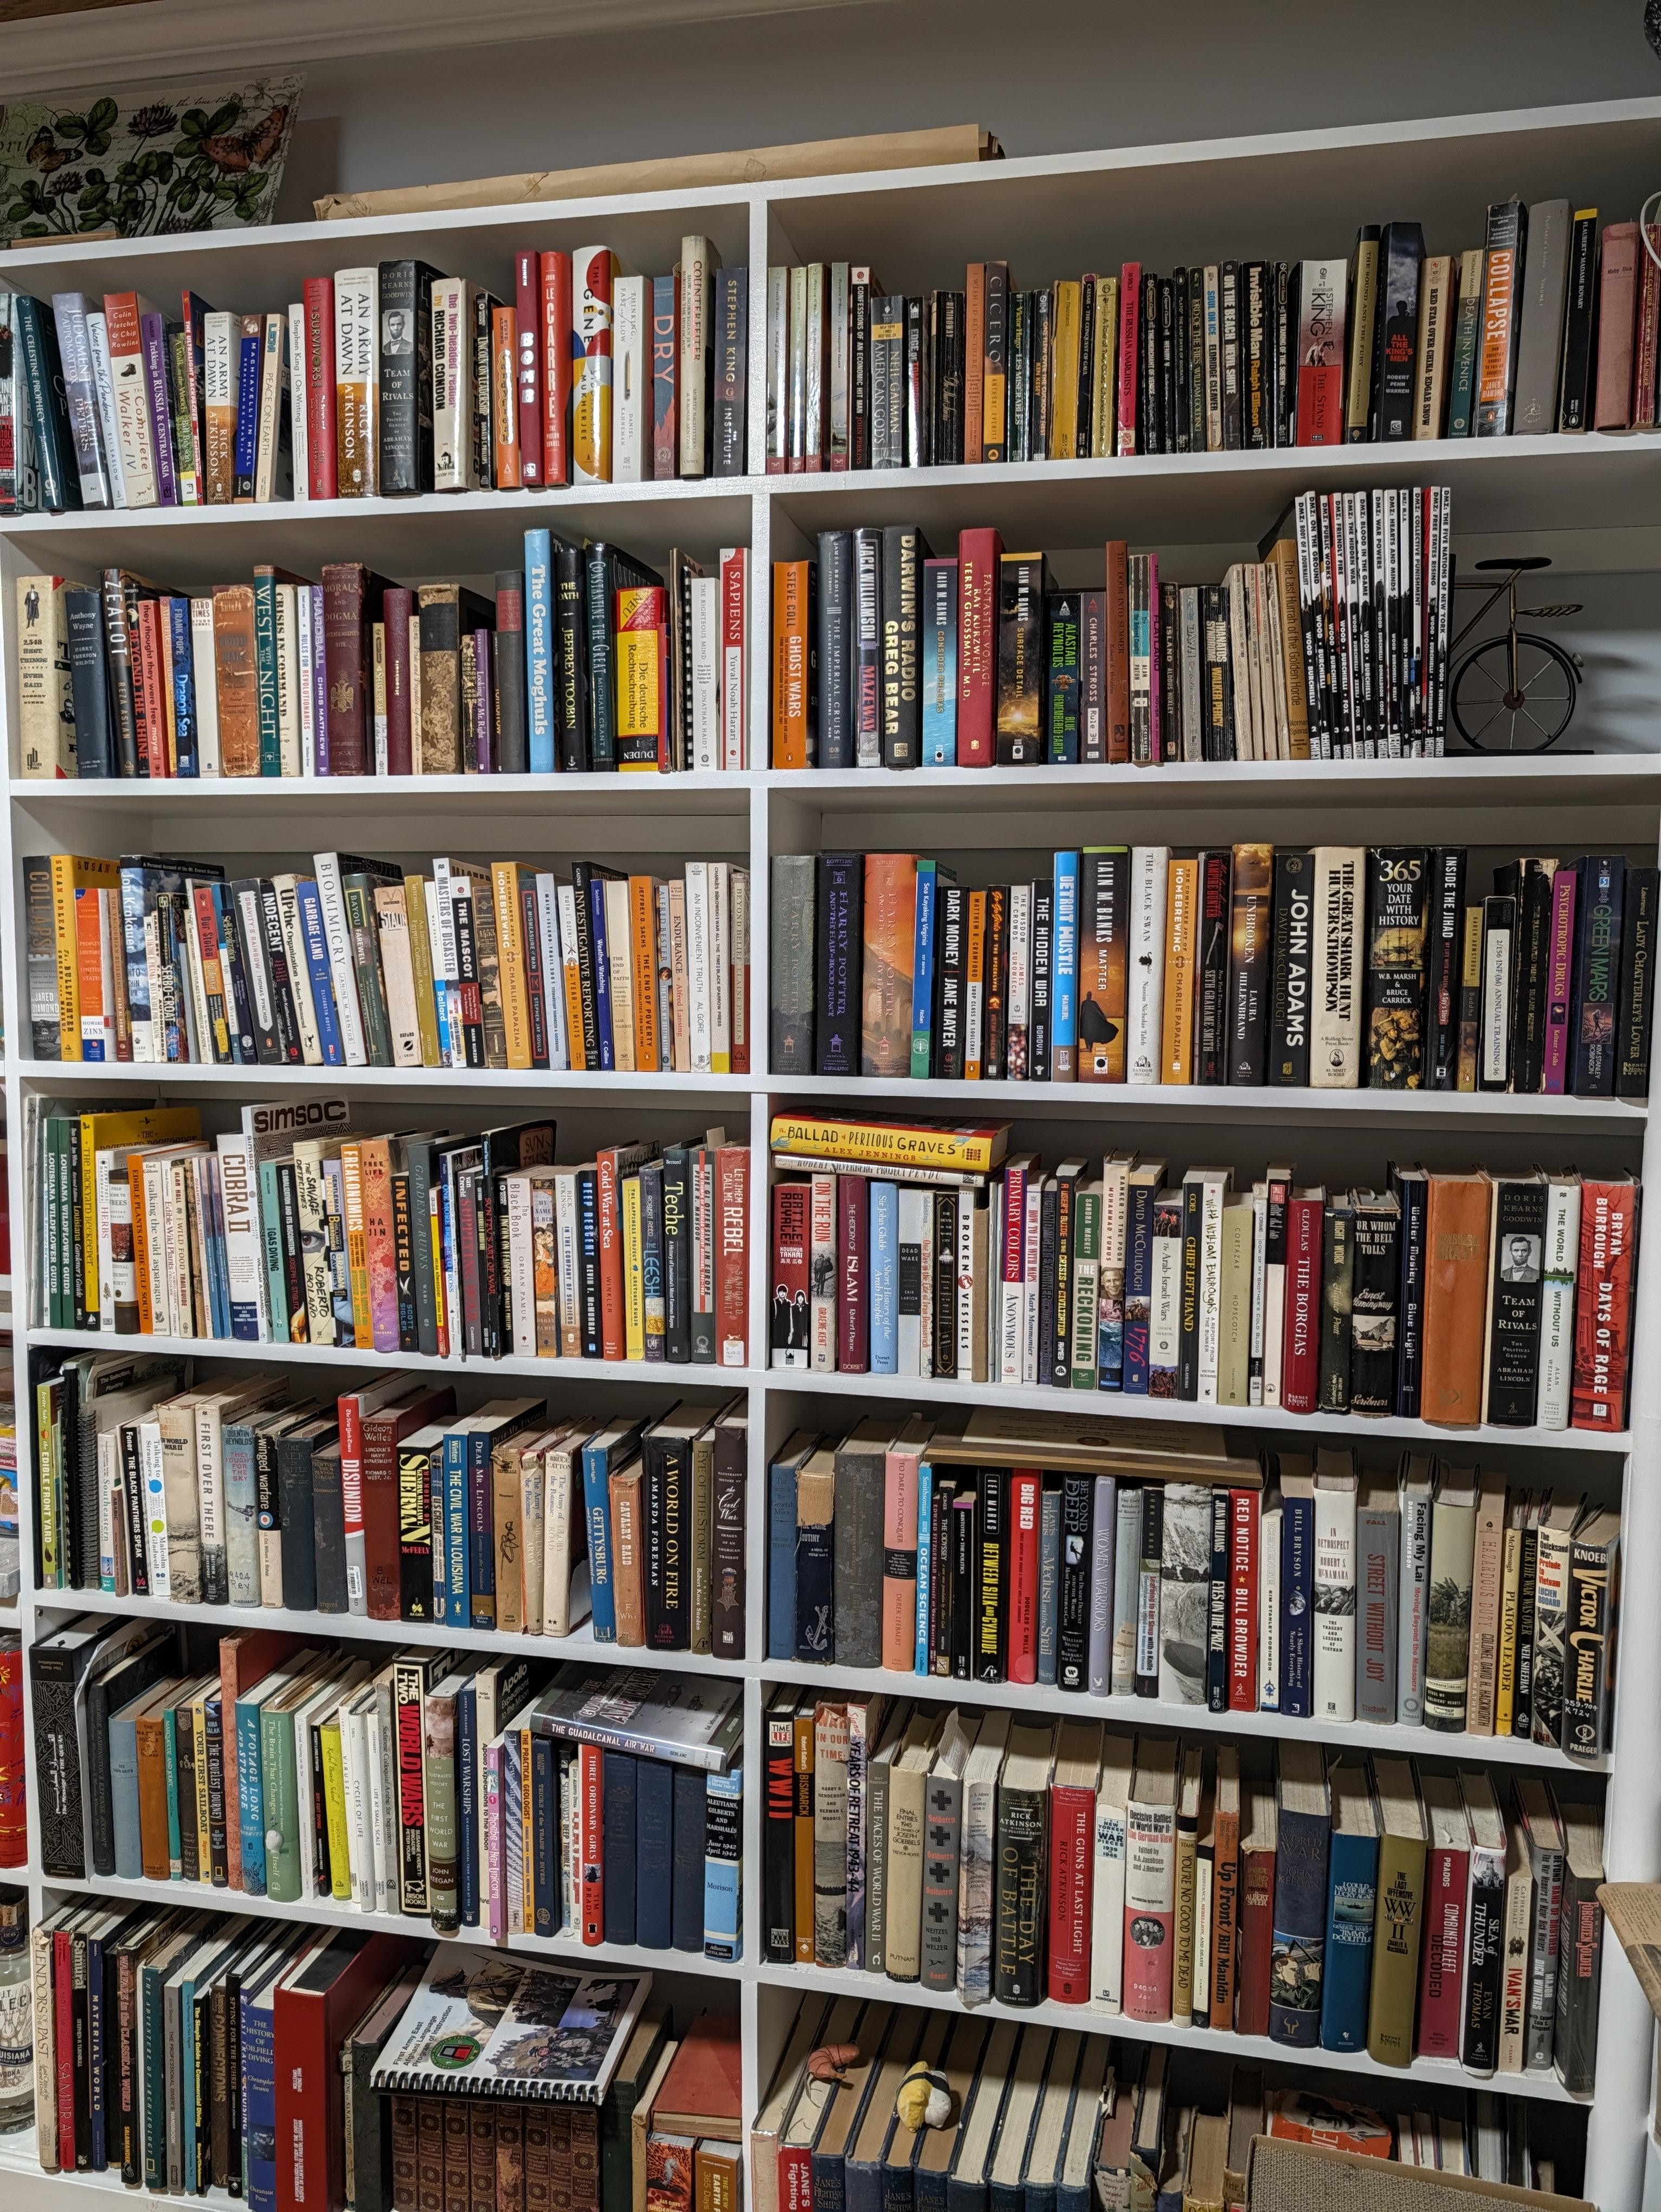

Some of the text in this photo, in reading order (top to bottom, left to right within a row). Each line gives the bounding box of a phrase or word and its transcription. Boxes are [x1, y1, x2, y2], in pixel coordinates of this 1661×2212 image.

[583, 287, 594, 343] GENE
[726, 280, 737, 382] STEPHEN KING
[989, 275, 1001, 363] CICERO
[1486, 252, 1511, 340] COLLAPSE
[340, 294, 355, 375] AT DAWN
[358, 293, 371, 376] AN ARMY
[520, 331, 535, 403] BOMB
[654, 314, 673, 384] DRY
[1458, 298, 1476, 392] DEATH IN VENICE
[344, 384, 355, 459] ATKINSON
[874, 342, 885, 444] AMERICAN GODS
[724, 408, 732, 465] INSTITUTE
[70, 612, 96, 631] Anthony Wayne
[105, 581, 127, 655] ZEALOT
[729, 571, 740, 640] SAPIENS
[531, 564, 549, 736] The Great Moghuls
[562, 628, 576, 729] JEFFREY TOOBIN
[789, 636, 802, 718] GHOST WARS
[885, 621, 898, 734] GREG BEAR
[1089, 665, 1097, 702] STROSS
[1379, 860, 1421, 881] 365
[1387, 884, 1413, 894] YOUR
[1388, 895, 1412, 904] DATE
[304, 898, 323, 960] GARBAGE LAND
[321, 863, 345, 964] BIOMIMICRY
[458, 902, 473, 979] THE MASCOT
[1379, 916, 1419, 925] HISTORY
[1386, 905, 1412, 915] WITH
[575, 891, 595, 1047] INVESTIGATIVE REPORTING
[942, 890, 961, 1047] DARK MONEY JANE MAYER
[1035, 897, 1049, 1007] THE HIDDEN WAR
[1287, 889, 1309, 1047] JOHN ADAMS
[788, 1126, 838, 1143] BALLAD
[848, 1131, 893, 1148] PERILOUS
[897, 1136, 956, 1155] GRAVES
[823, 1146, 916, 1161] ALEX JENNINGS
[223, 1154, 249, 1216] COBRA
[344, 1151, 363, 1231] FREAKONOMICS
[601, 1161, 612, 1249] Cold War at Sea
[665, 1182, 685, 1235] Teche
[228, 1220, 250, 1234] II
[395, 1181, 408, 1271] INFECTED
[1007, 1169, 1021, 1280] PRIMARY COLORS
[847, 1256, 858, 1302] ISLAM
[1076, 1265, 1095, 1362] THE RECKONING
[1295, 1258, 1310, 1355] THE BORGIAS
[1512, 1310, 1524, 1318] OF
[1550, 1291, 1562, 1348] WITHOUT US
[1594, 1283, 1613, 1395] DAYS OF RAGE
[363, 1424, 392, 1433] Gideon
[364, 1433, 392, 1442] Welles
[201, 1423, 215, 1539] FIRST OVER THERE
[343, 1459, 363, 1522] DISUNION
[400, 1454, 430, 1546] SHERMAN
[1020, 1484, 1034, 1529] BIG RED
[449, 1470, 463, 1594] THE CIVIL WAR IN LOUISIANA
[592, 1507, 608, 1585] GETTYSBURG
[918, 1548, 928, 1644] OCEAN SCIENCE
[1093, 1528, 1109, 1632] WOMEN WARRIORS
[1233, 1497, 1251, 1677] RED NOTICE BILL BROWDER
[397, 1672, 419, 1705] THE TWO
[399, 1705, 423, 1827] WORLD WARS
[551, 1724, 655, 1754] THE GUADALCANAL AIR WAR
[1569, 1744, 1598, 1754] PRAEGER
[196, 1731, 208, 1834] YOUR FIRST SAILBOAT
[799, 1774, 809, 1816] BISMARCK
[1000, 1819, 1042, 1828] ATKINSON
[706, 1881, 733, 1893] Morison
[393, 2022, 423, 2065] First Army East
[403, 2016, 437, 2066] Afghani Language
[412, 2042, 431, 2067] Program
[434, 2005, 453, 2034] Instruction
[57, 2061, 72, 2140] SAMURAI
[788, 2163, 798, 2210] Fighting
[800, 2163, 810, 2207] JANE'S
